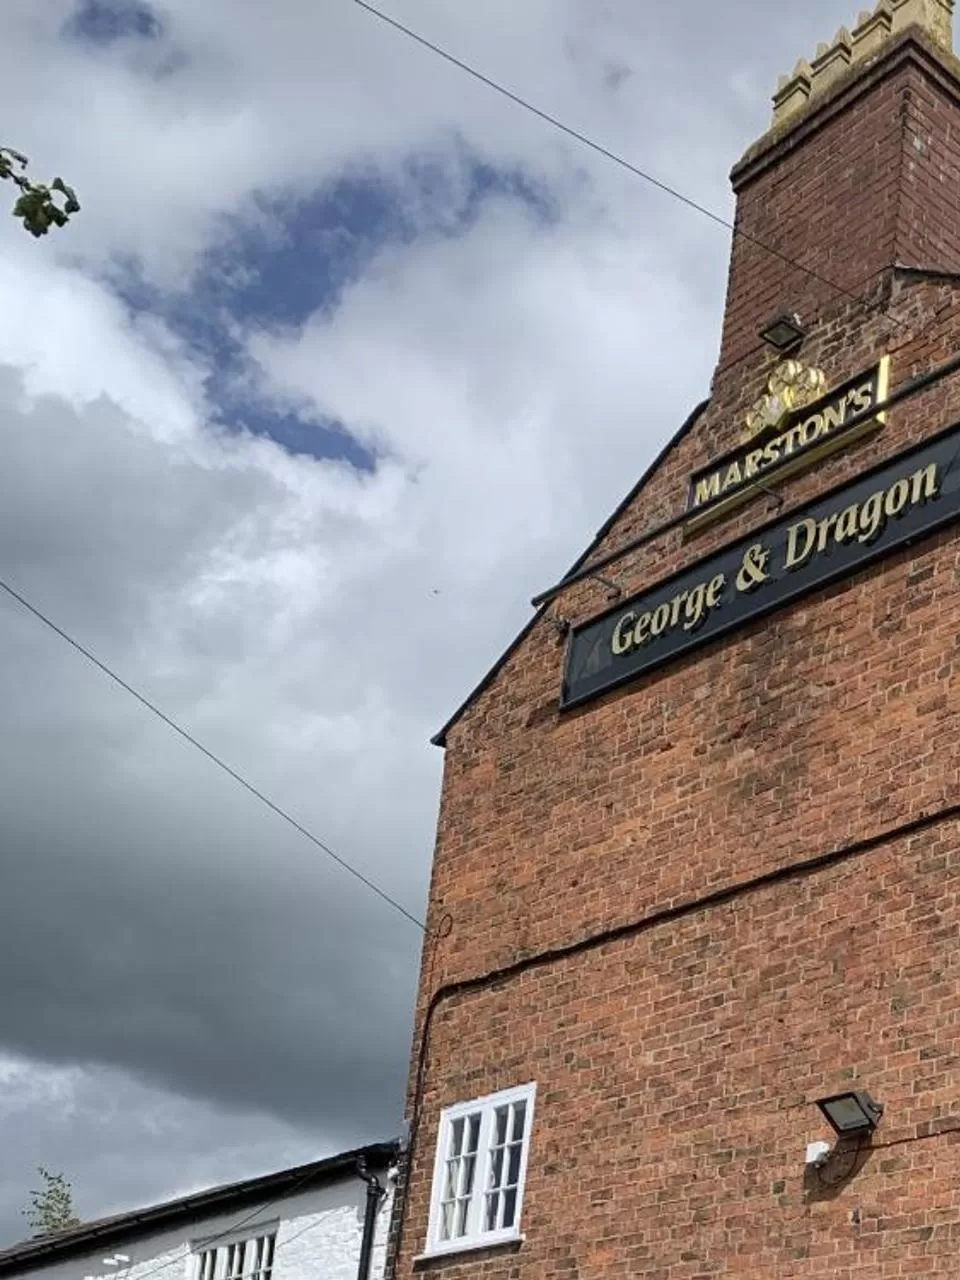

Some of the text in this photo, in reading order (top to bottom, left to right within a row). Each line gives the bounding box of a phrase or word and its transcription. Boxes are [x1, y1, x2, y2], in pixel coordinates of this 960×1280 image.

[693, 382, 875, 506] MARSTON'S
[611, 462, 938, 656] George & Dragon
